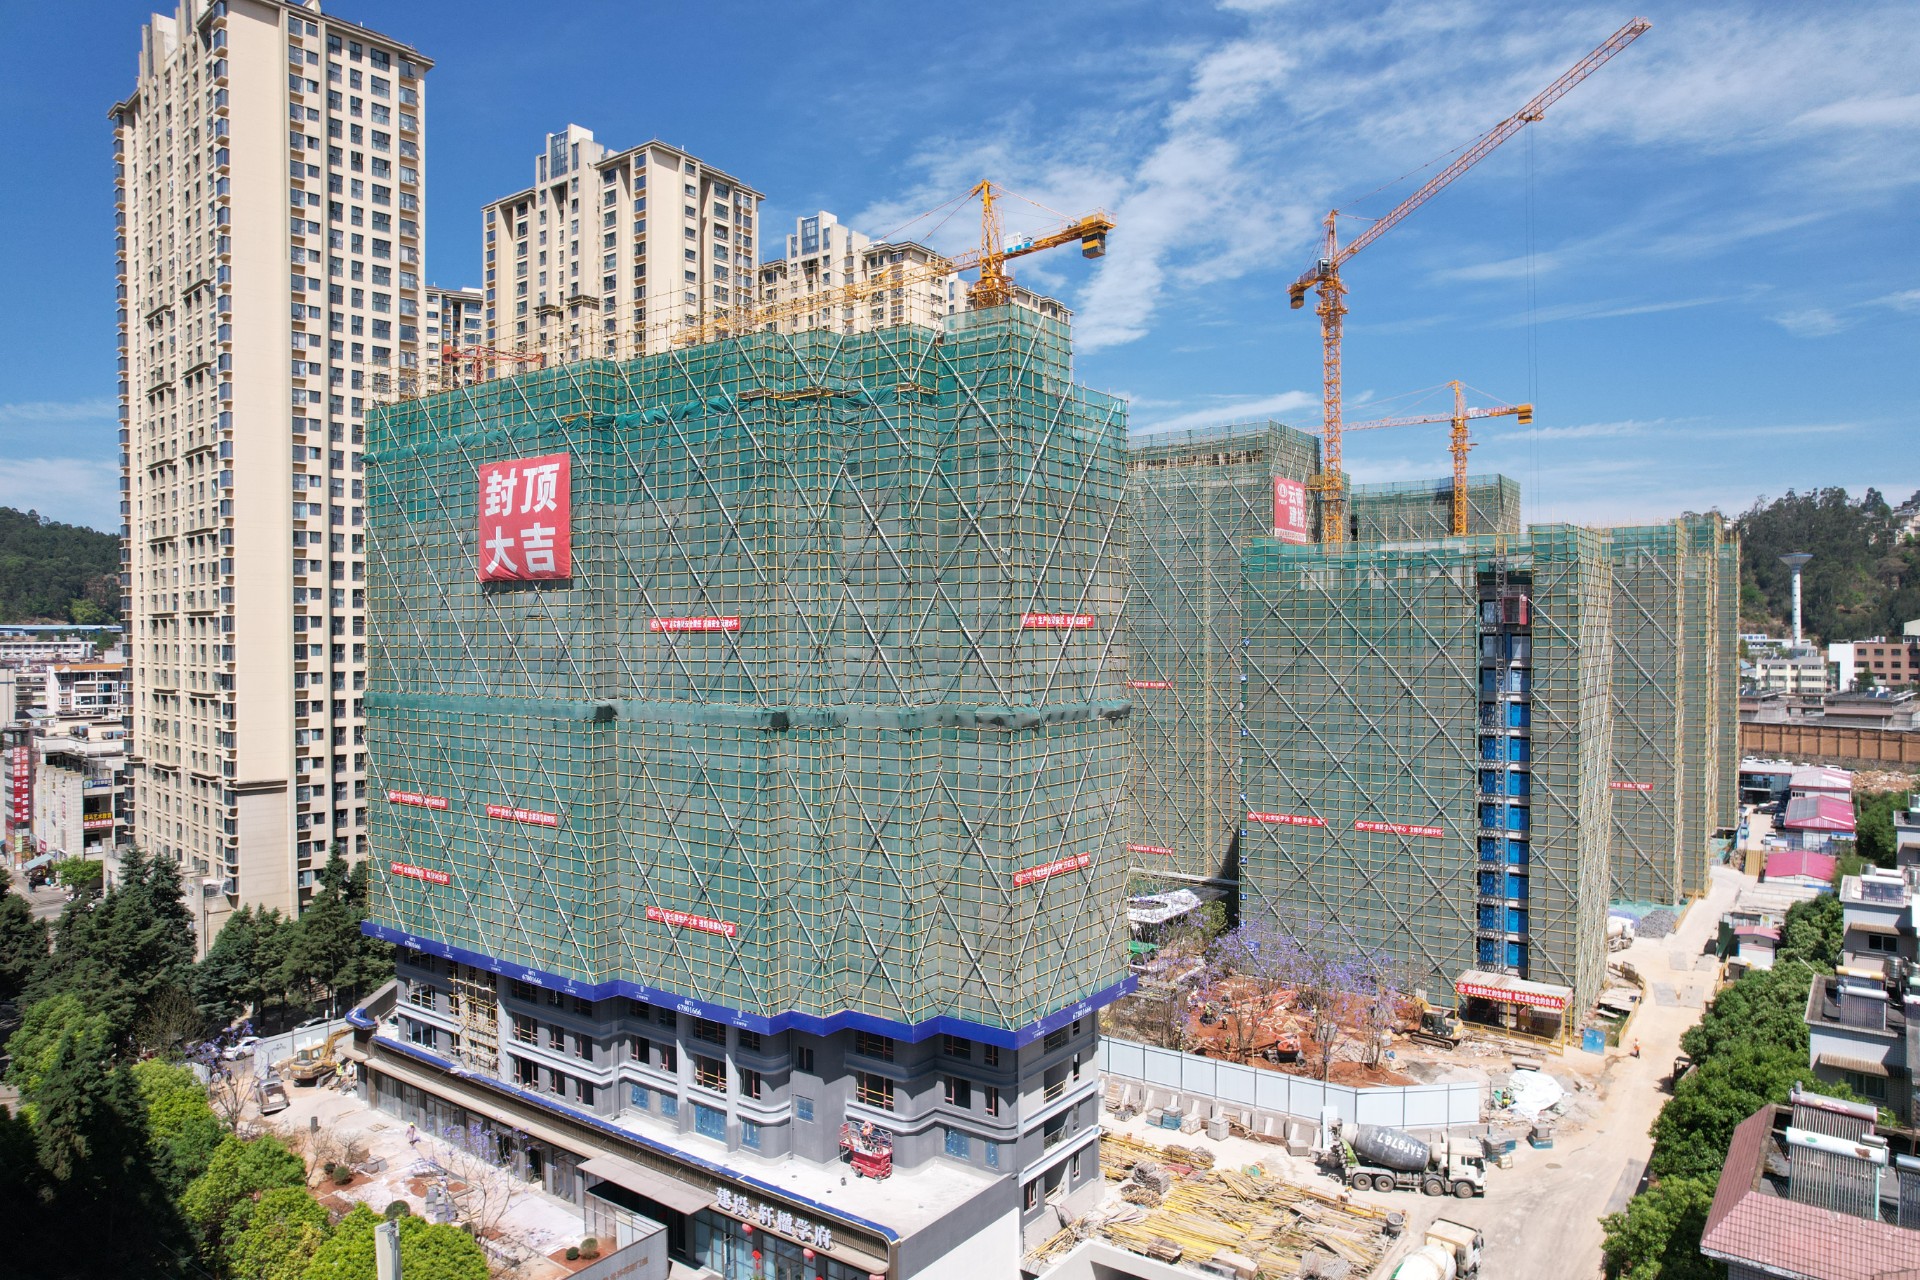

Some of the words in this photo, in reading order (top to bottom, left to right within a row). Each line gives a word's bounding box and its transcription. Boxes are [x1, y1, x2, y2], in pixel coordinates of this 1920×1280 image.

[485, 463, 559, 516] 封顶
[1288, 485, 1304, 507] 云南
[1288, 506, 1304, 528] 建投
[485, 522, 556, 573] 大吉
[665, 912, 697, 926] 安全是生产之本
[522, 974, 542, 985] 67801666
[1467, 985, 1512, 1000] 安全是职工的生命线
[1514, 993, 1561, 1007] 职工是安全的负责人
[677, 1003, 702, 1016] 67801666
